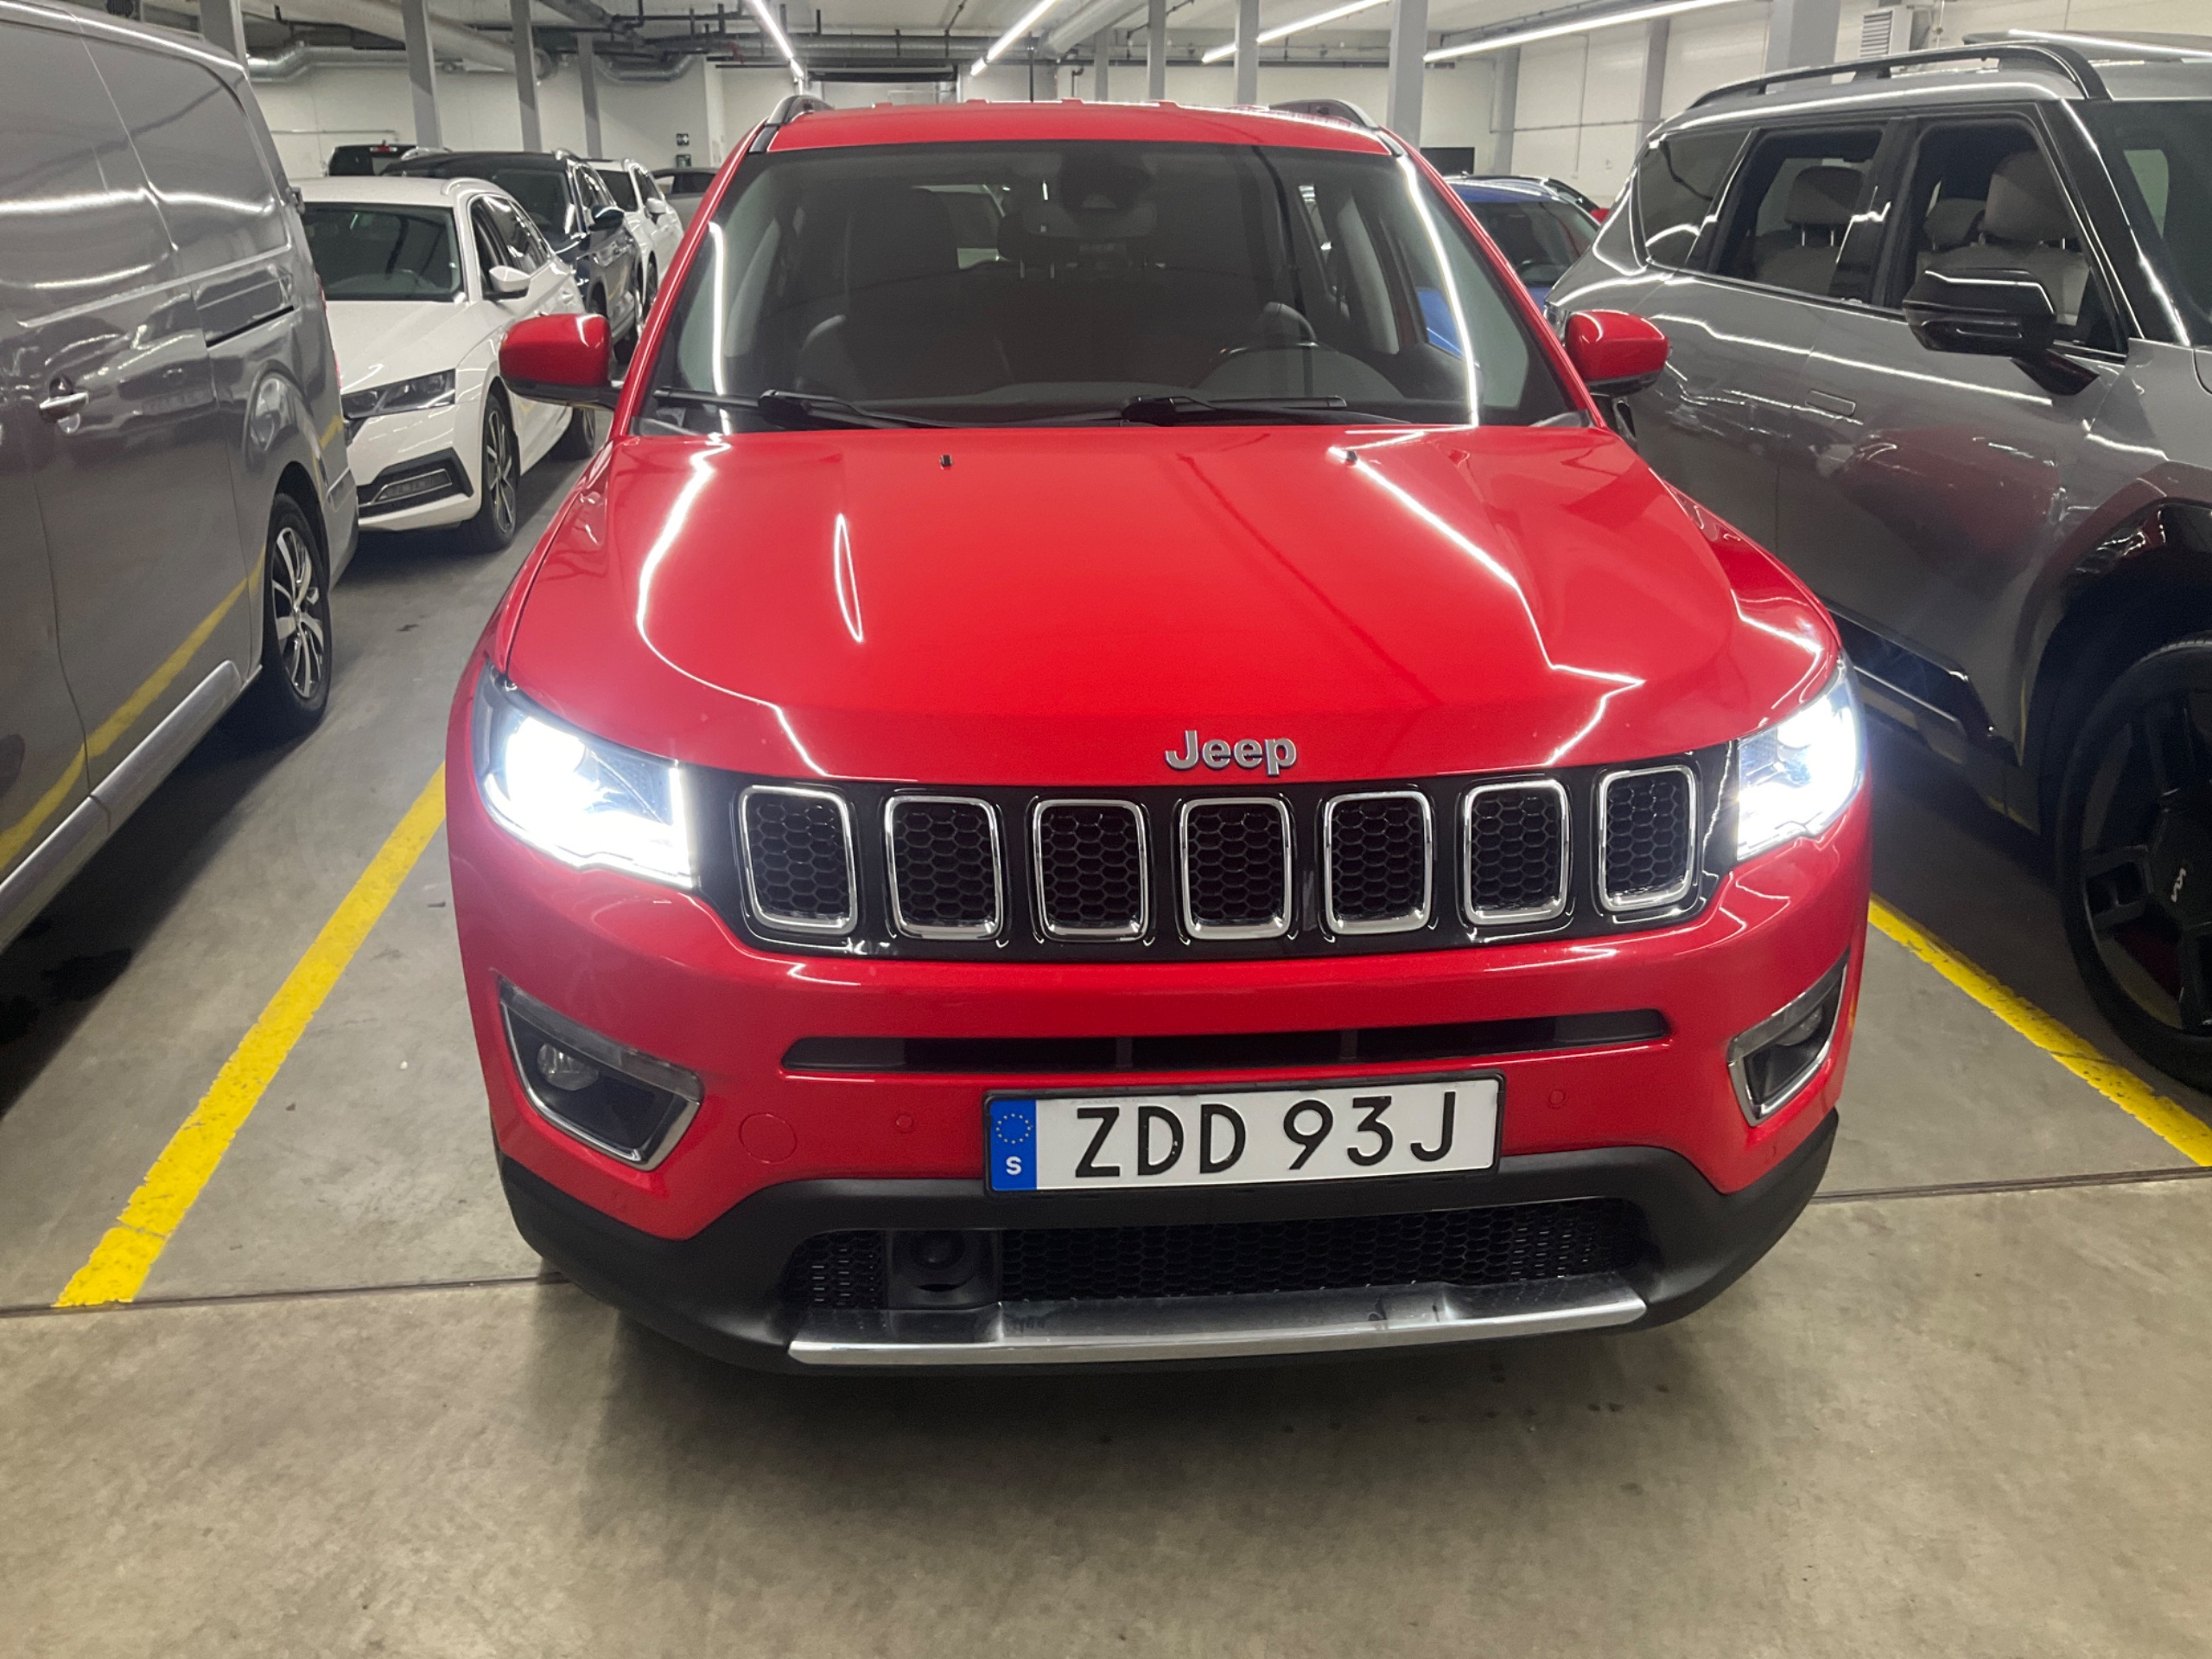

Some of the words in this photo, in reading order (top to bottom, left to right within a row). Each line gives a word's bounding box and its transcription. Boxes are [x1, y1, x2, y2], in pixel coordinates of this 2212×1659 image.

[1164, 729, 1297, 777] Jeep
[1075, 1103, 1246, 1179] ZDD
[1282, 1090, 1458, 1170] 93J
[1006, 1155, 1021, 1175] S
